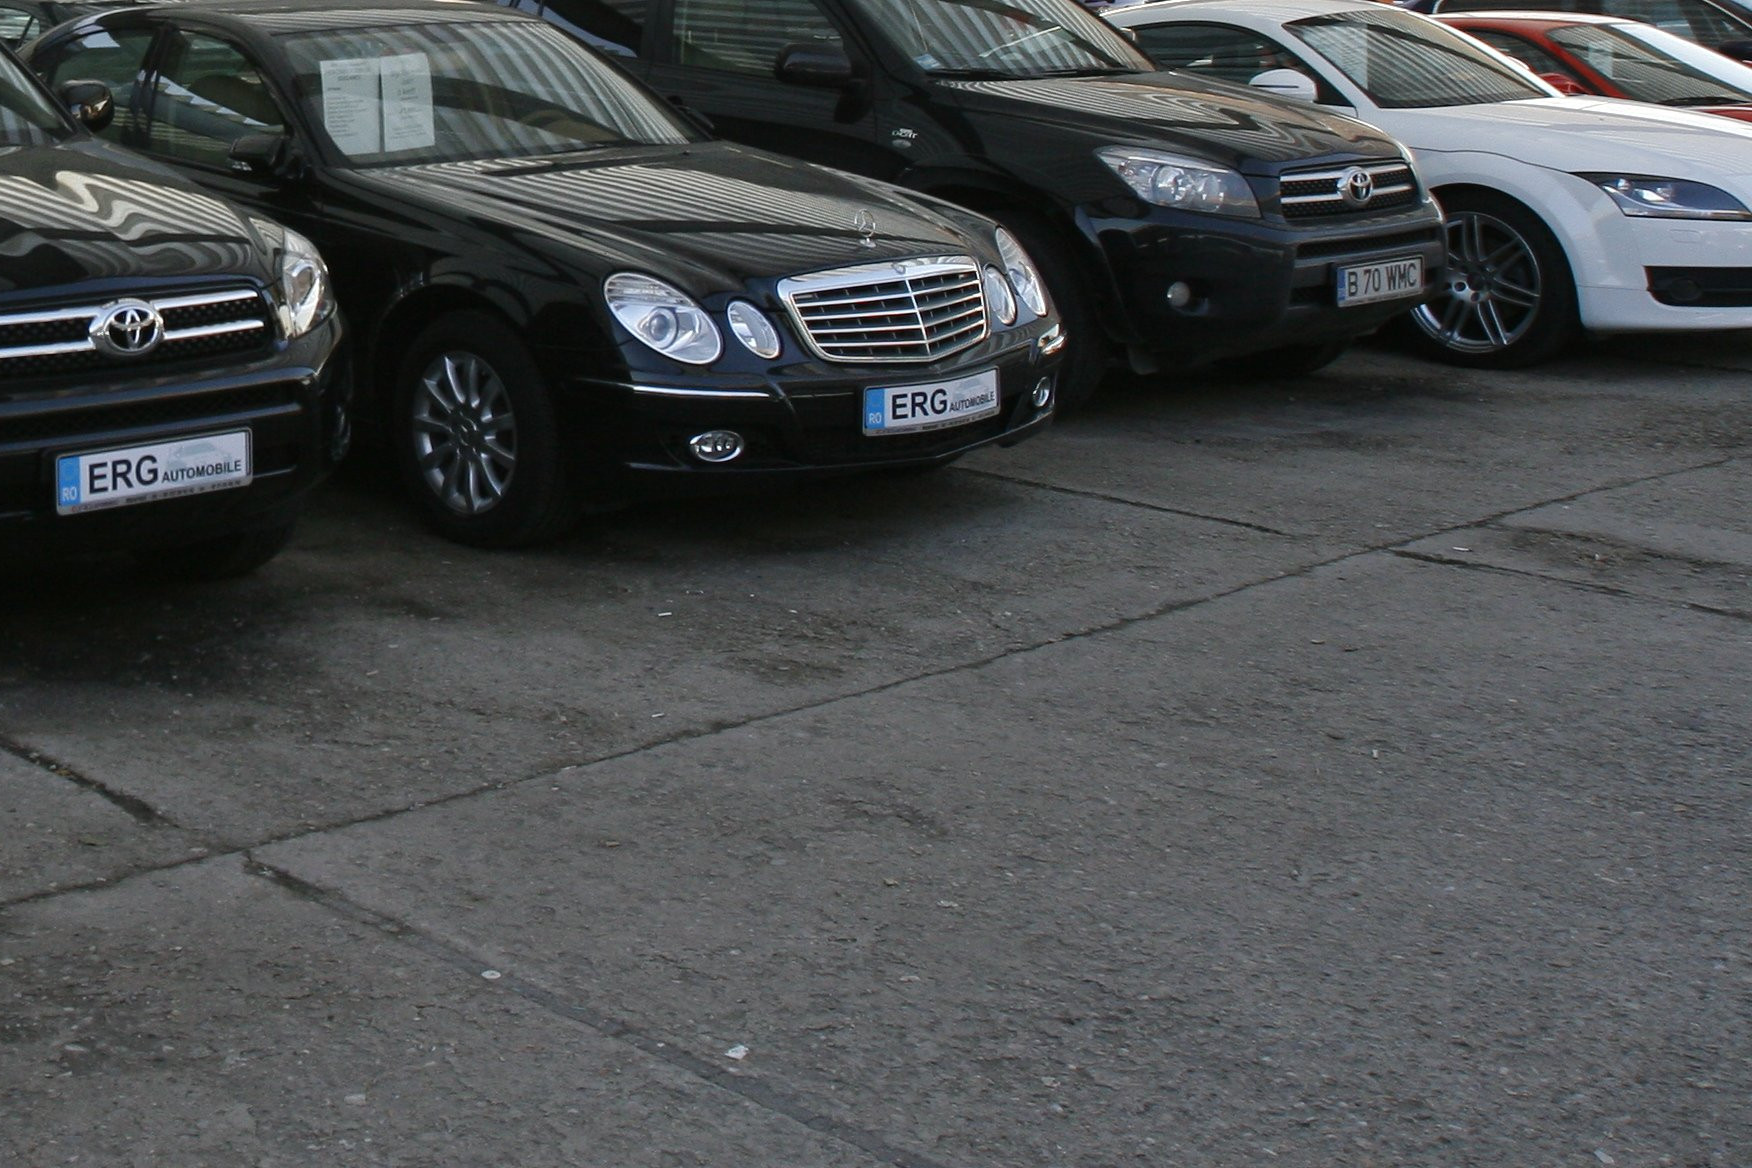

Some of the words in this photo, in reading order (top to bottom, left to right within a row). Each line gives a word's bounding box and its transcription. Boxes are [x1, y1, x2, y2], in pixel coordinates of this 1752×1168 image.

[1348, 270, 1359, 297] B
[1363, 268, 1380, 294] 70
[1385, 263, 1416, 290] WMC
[868, 412, 882, 424] RO
[891, 388, 948, 420] ERG
[949, 391, 995, 411] AUTOMOBILE
[88, 454, 159, 495] ERG
[162, 460, 241, 483] AUTOMOBILE
[62, 485, 78, 502] RO
